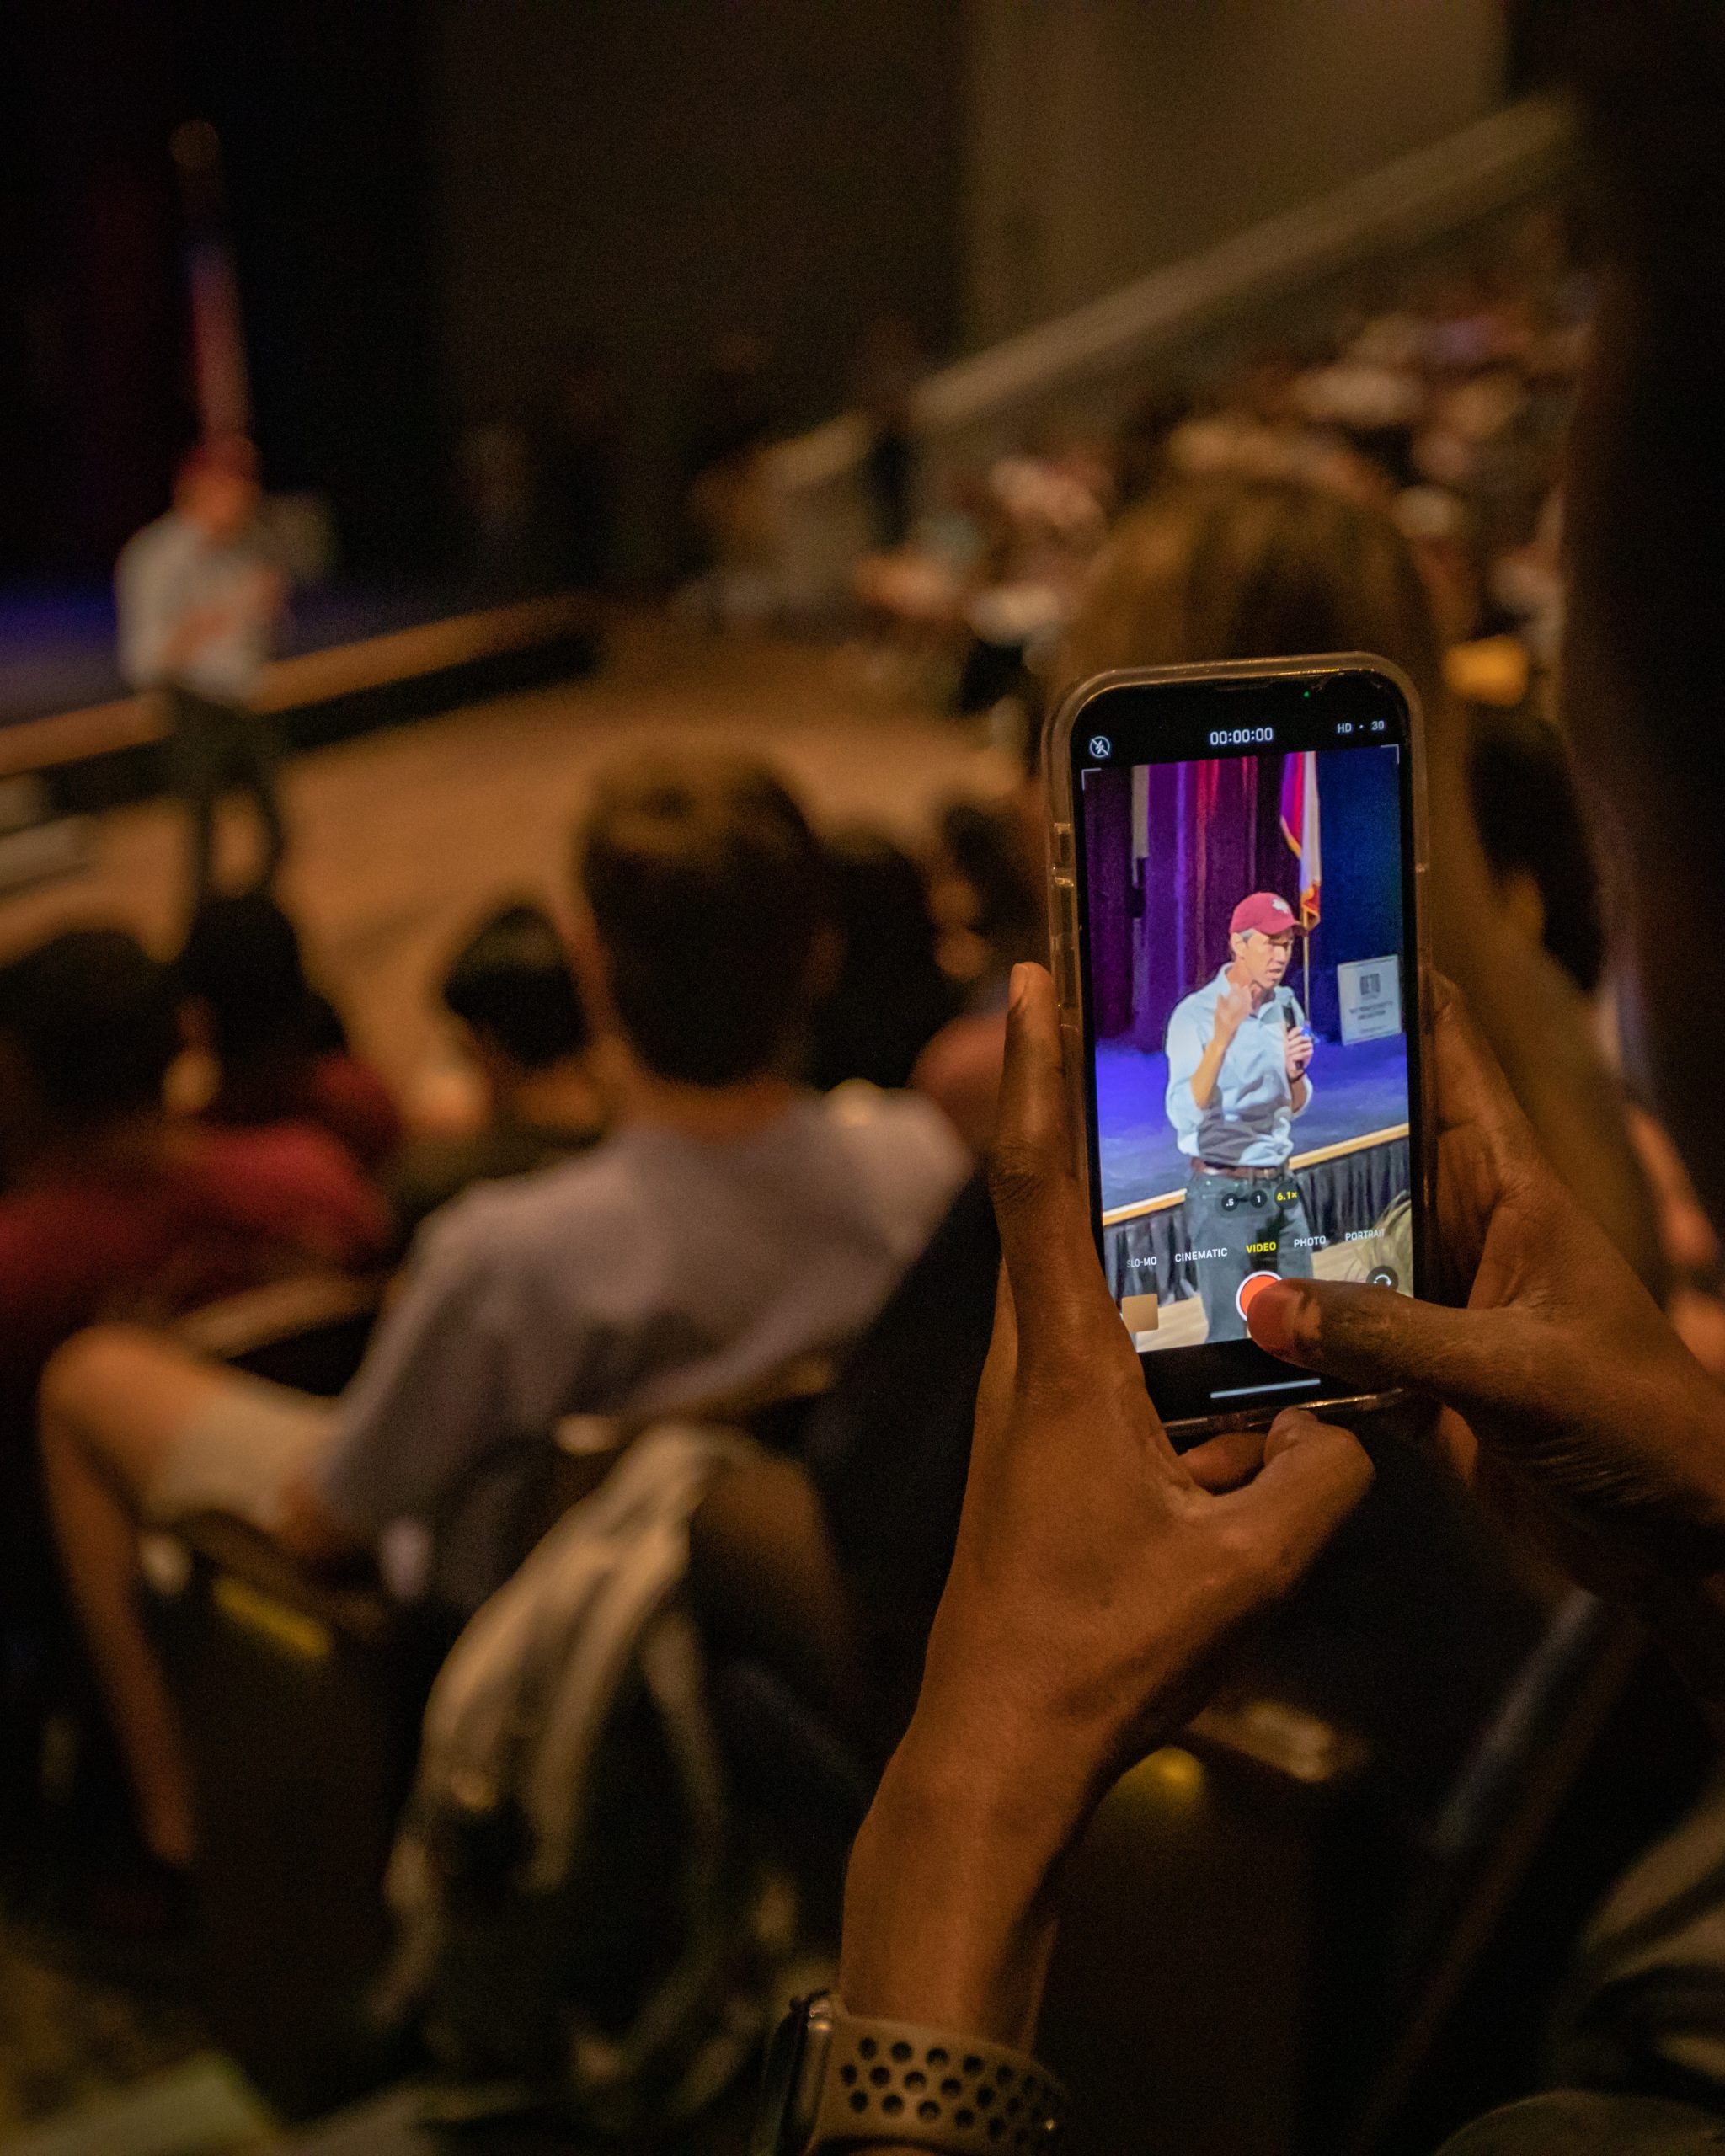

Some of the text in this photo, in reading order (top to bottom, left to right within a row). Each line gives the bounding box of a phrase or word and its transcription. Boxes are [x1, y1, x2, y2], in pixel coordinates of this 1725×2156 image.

[1210, 727, 1274, 745] 00:00:00
[1337, 720, 1385, 734] HD 30
[1126, 1228, 1386, 1268] SLO-MO CINEMATIC VIDEO PHOTO PORTRAIT
